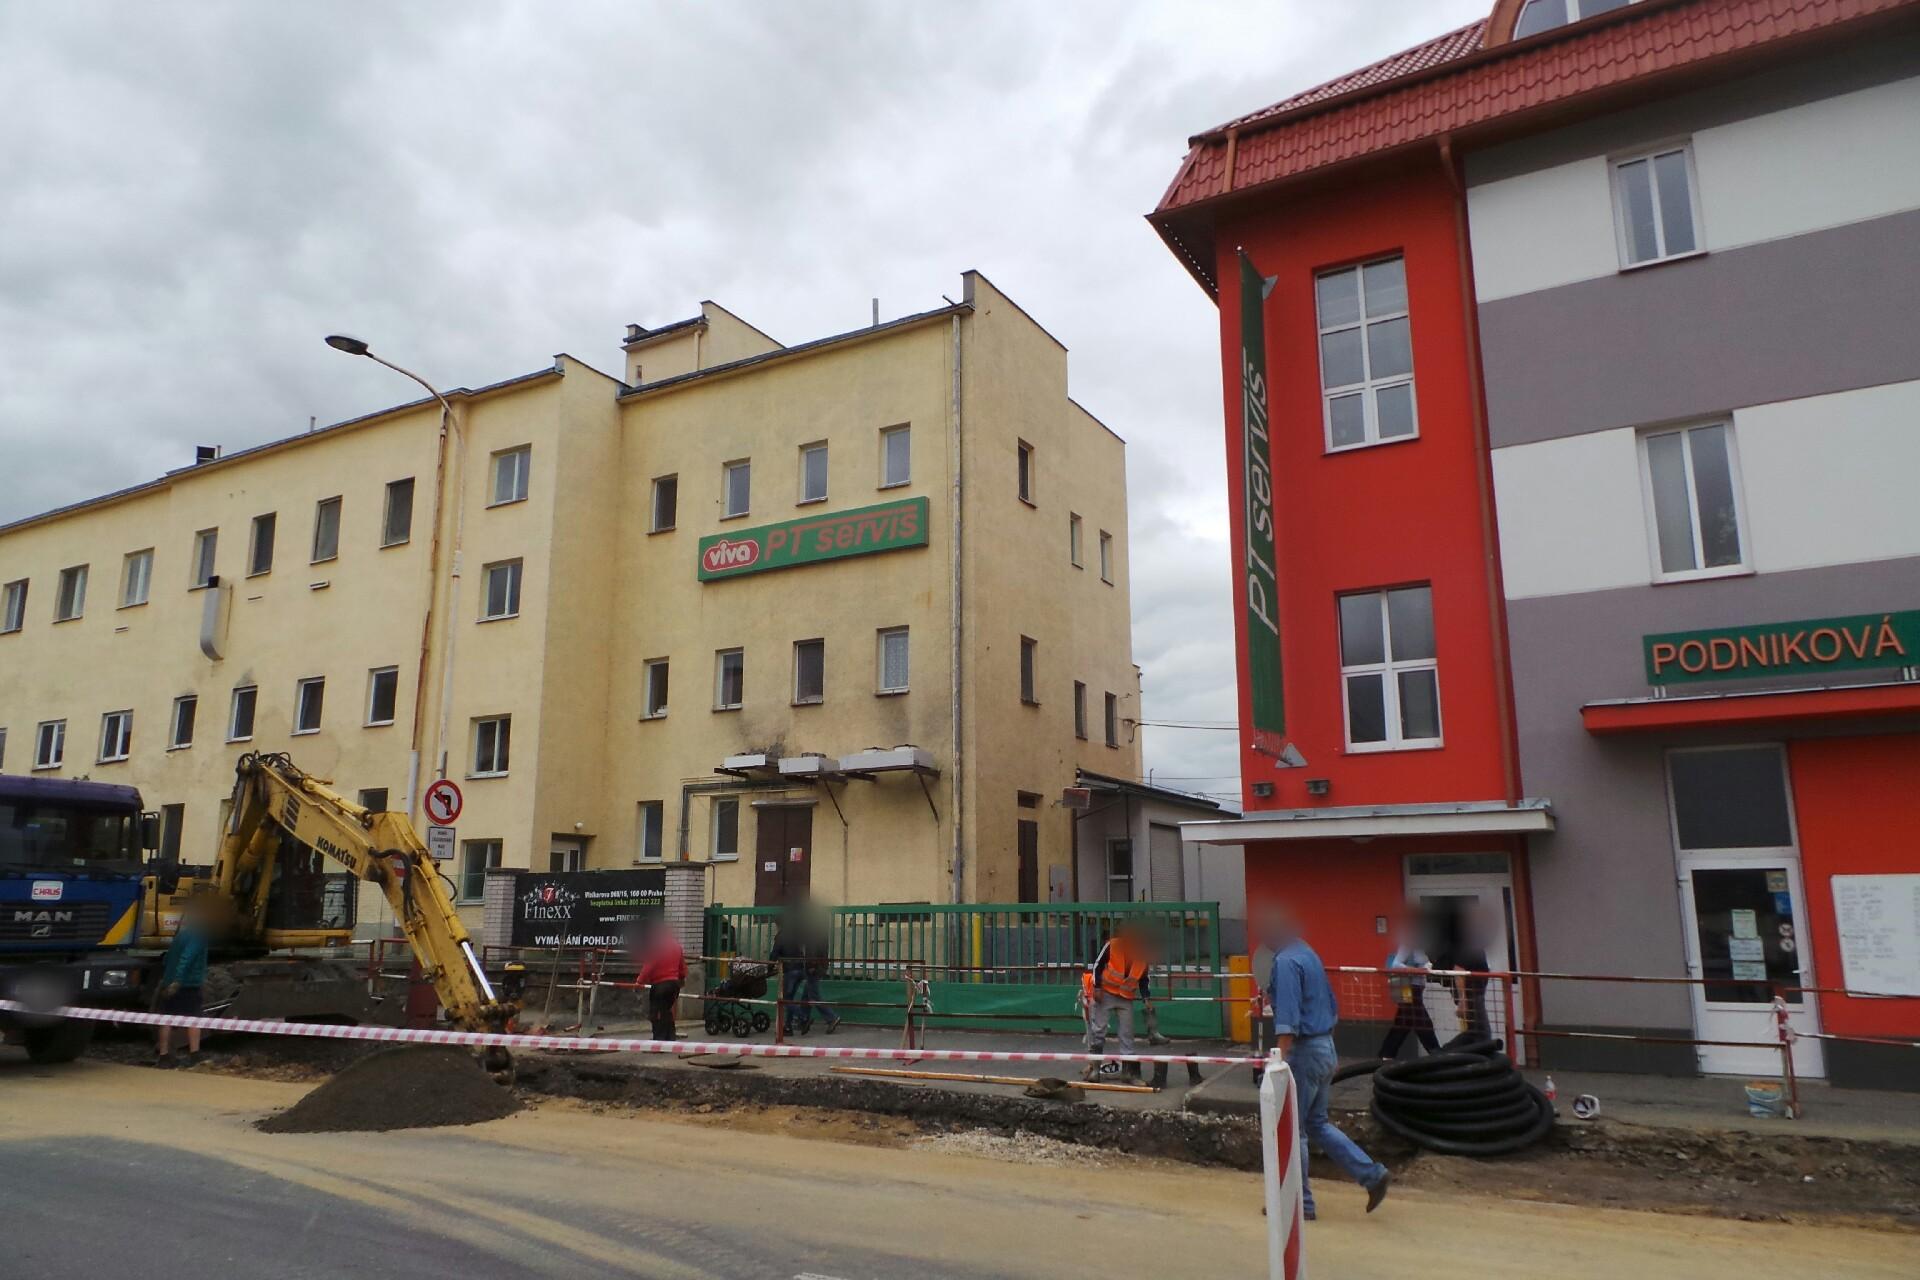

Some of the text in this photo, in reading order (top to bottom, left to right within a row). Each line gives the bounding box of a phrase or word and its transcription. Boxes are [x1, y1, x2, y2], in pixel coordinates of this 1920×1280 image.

[1247, 362, 1279, 635] PT servis
[764, 509, 918, 561] PT servis
[709, 542, 751, 567] viva
[1652, 615, 1905, 675] PODNIKOVÁ
[317, 836, 357, 869] KOMATSU
[14, 911, 73, 922] MAN
[535, 934, 581, 945] VYMÁÁNÍ
